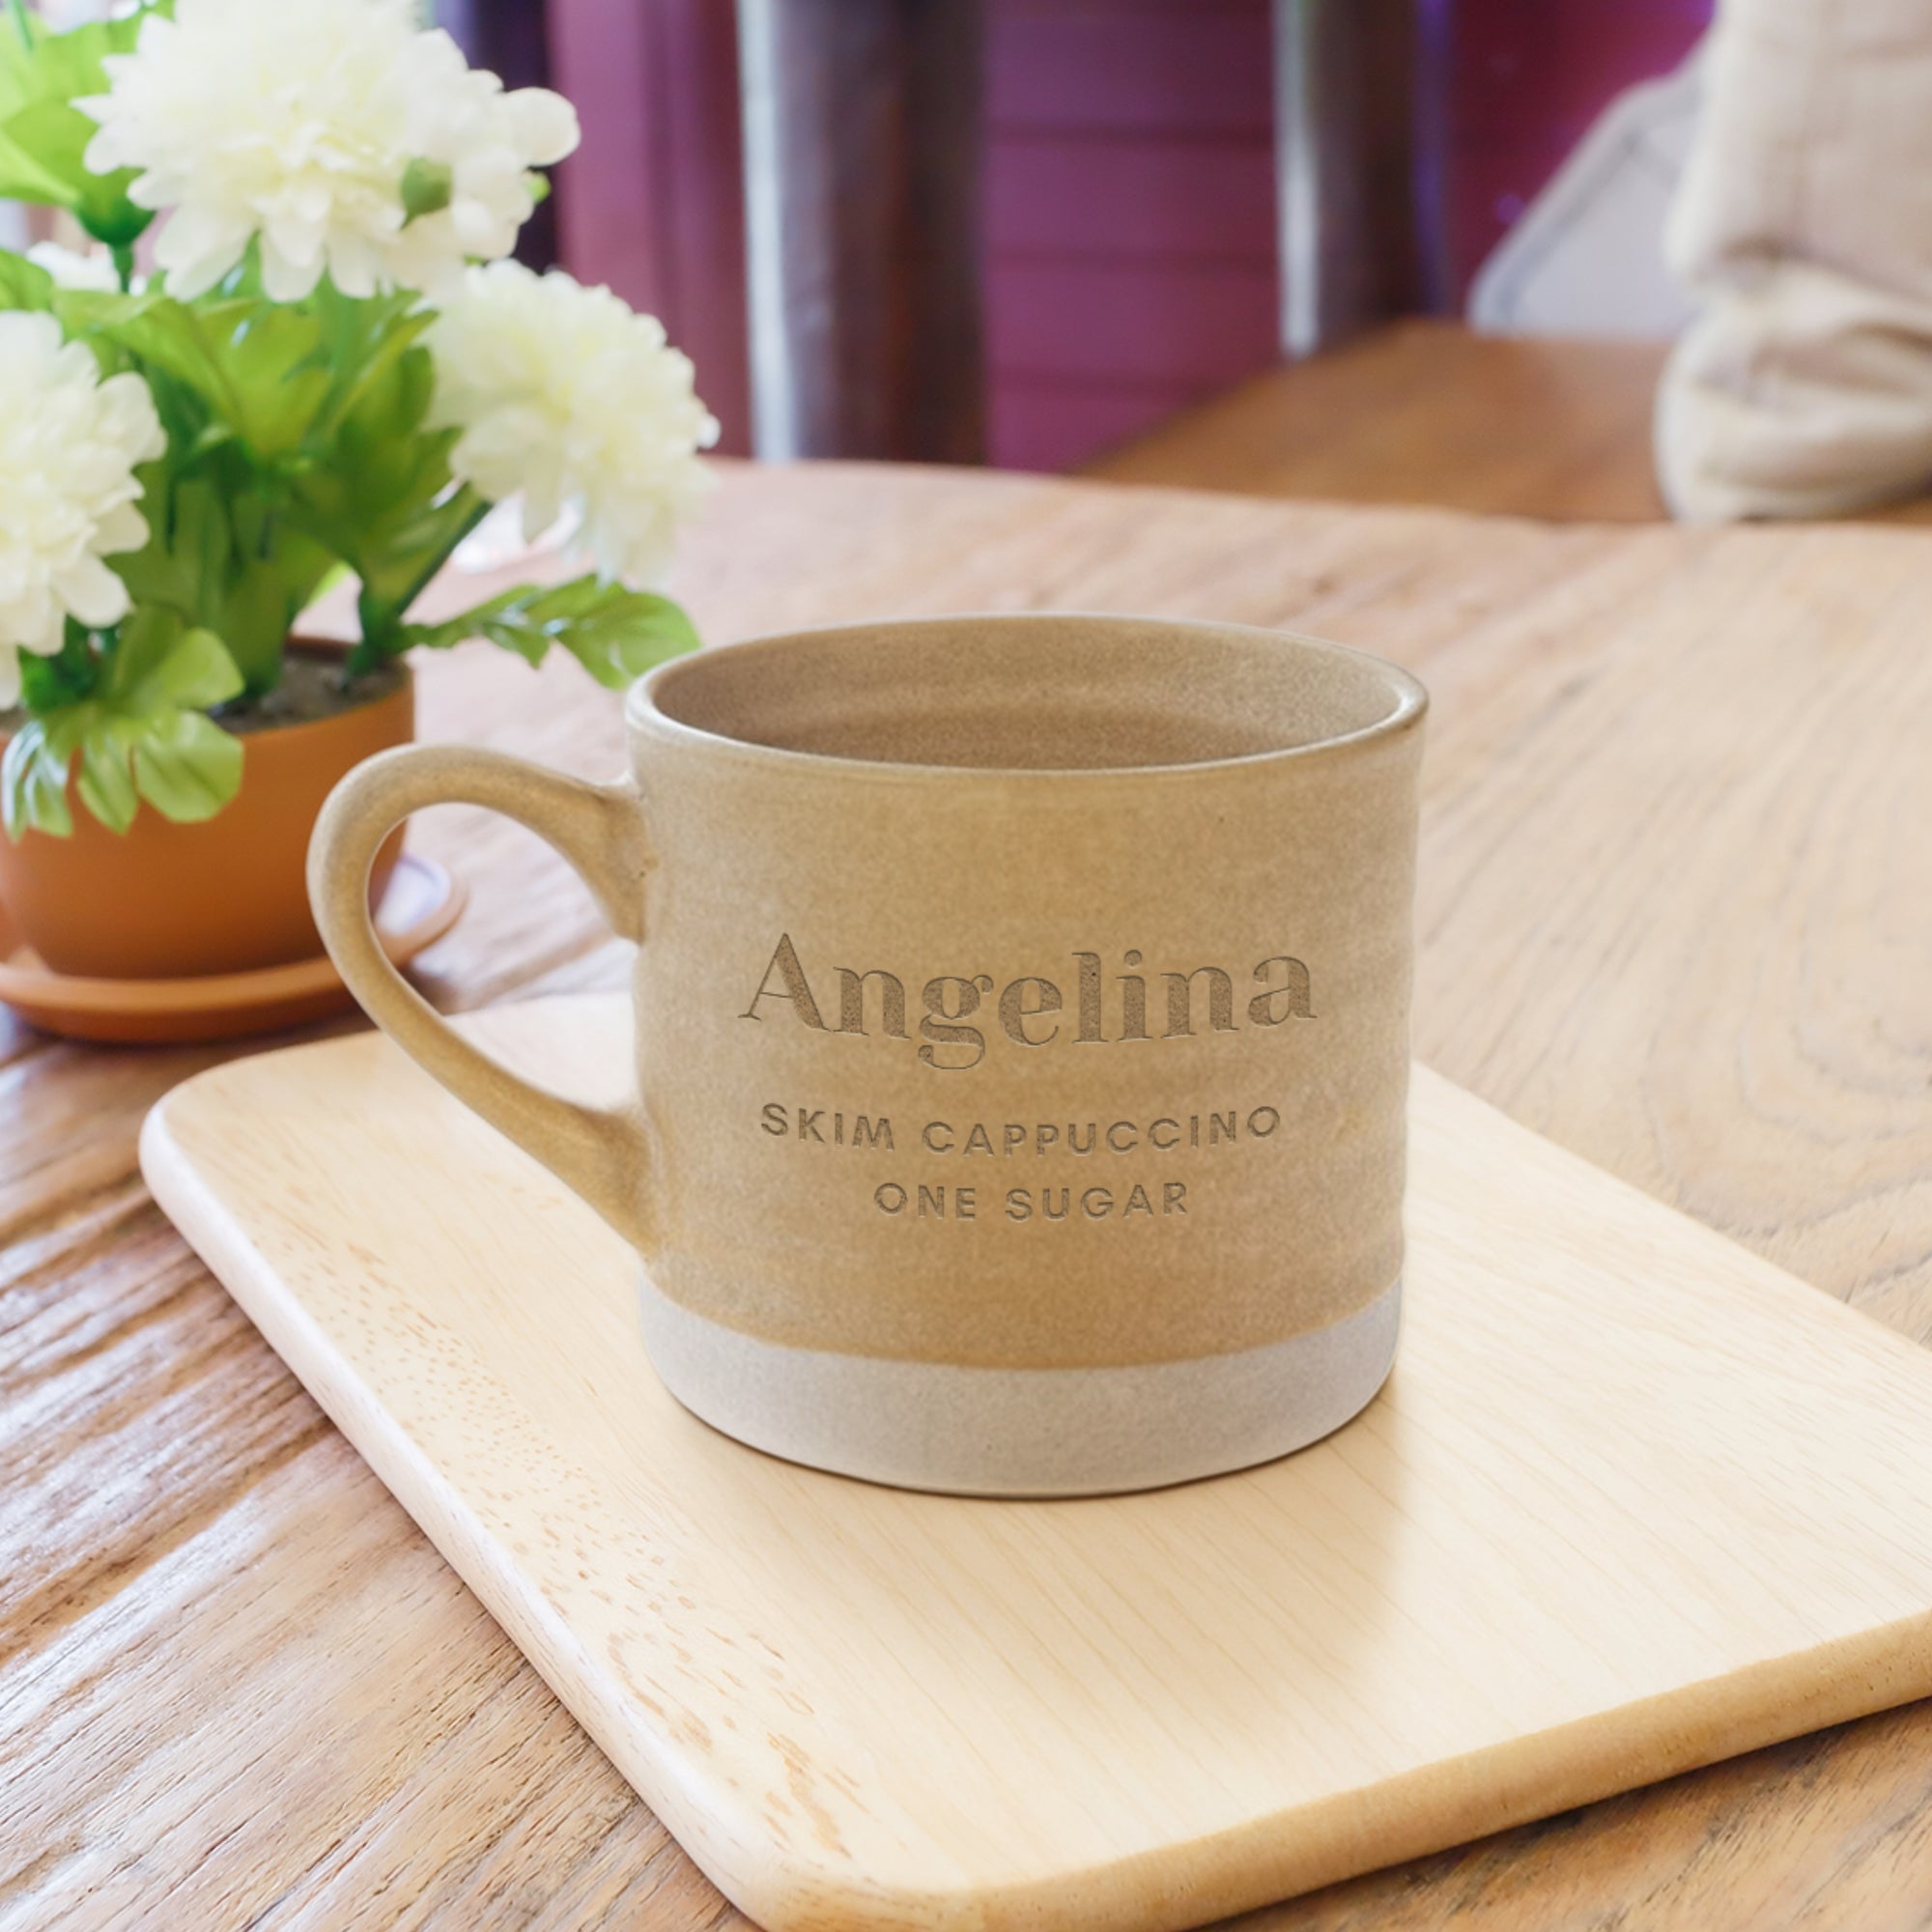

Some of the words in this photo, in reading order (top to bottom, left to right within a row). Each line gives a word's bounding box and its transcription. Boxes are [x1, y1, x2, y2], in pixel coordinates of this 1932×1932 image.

[737, 932, 1318, 1070] Angelina
[760, 1103, 895, 1151] SKIM
[922, 1105, 1281, 1157] CAPPUCCINO
[873, 1182, 977, 1220] ONE
[1004, 1182, 1188, 1223] SUGAR
